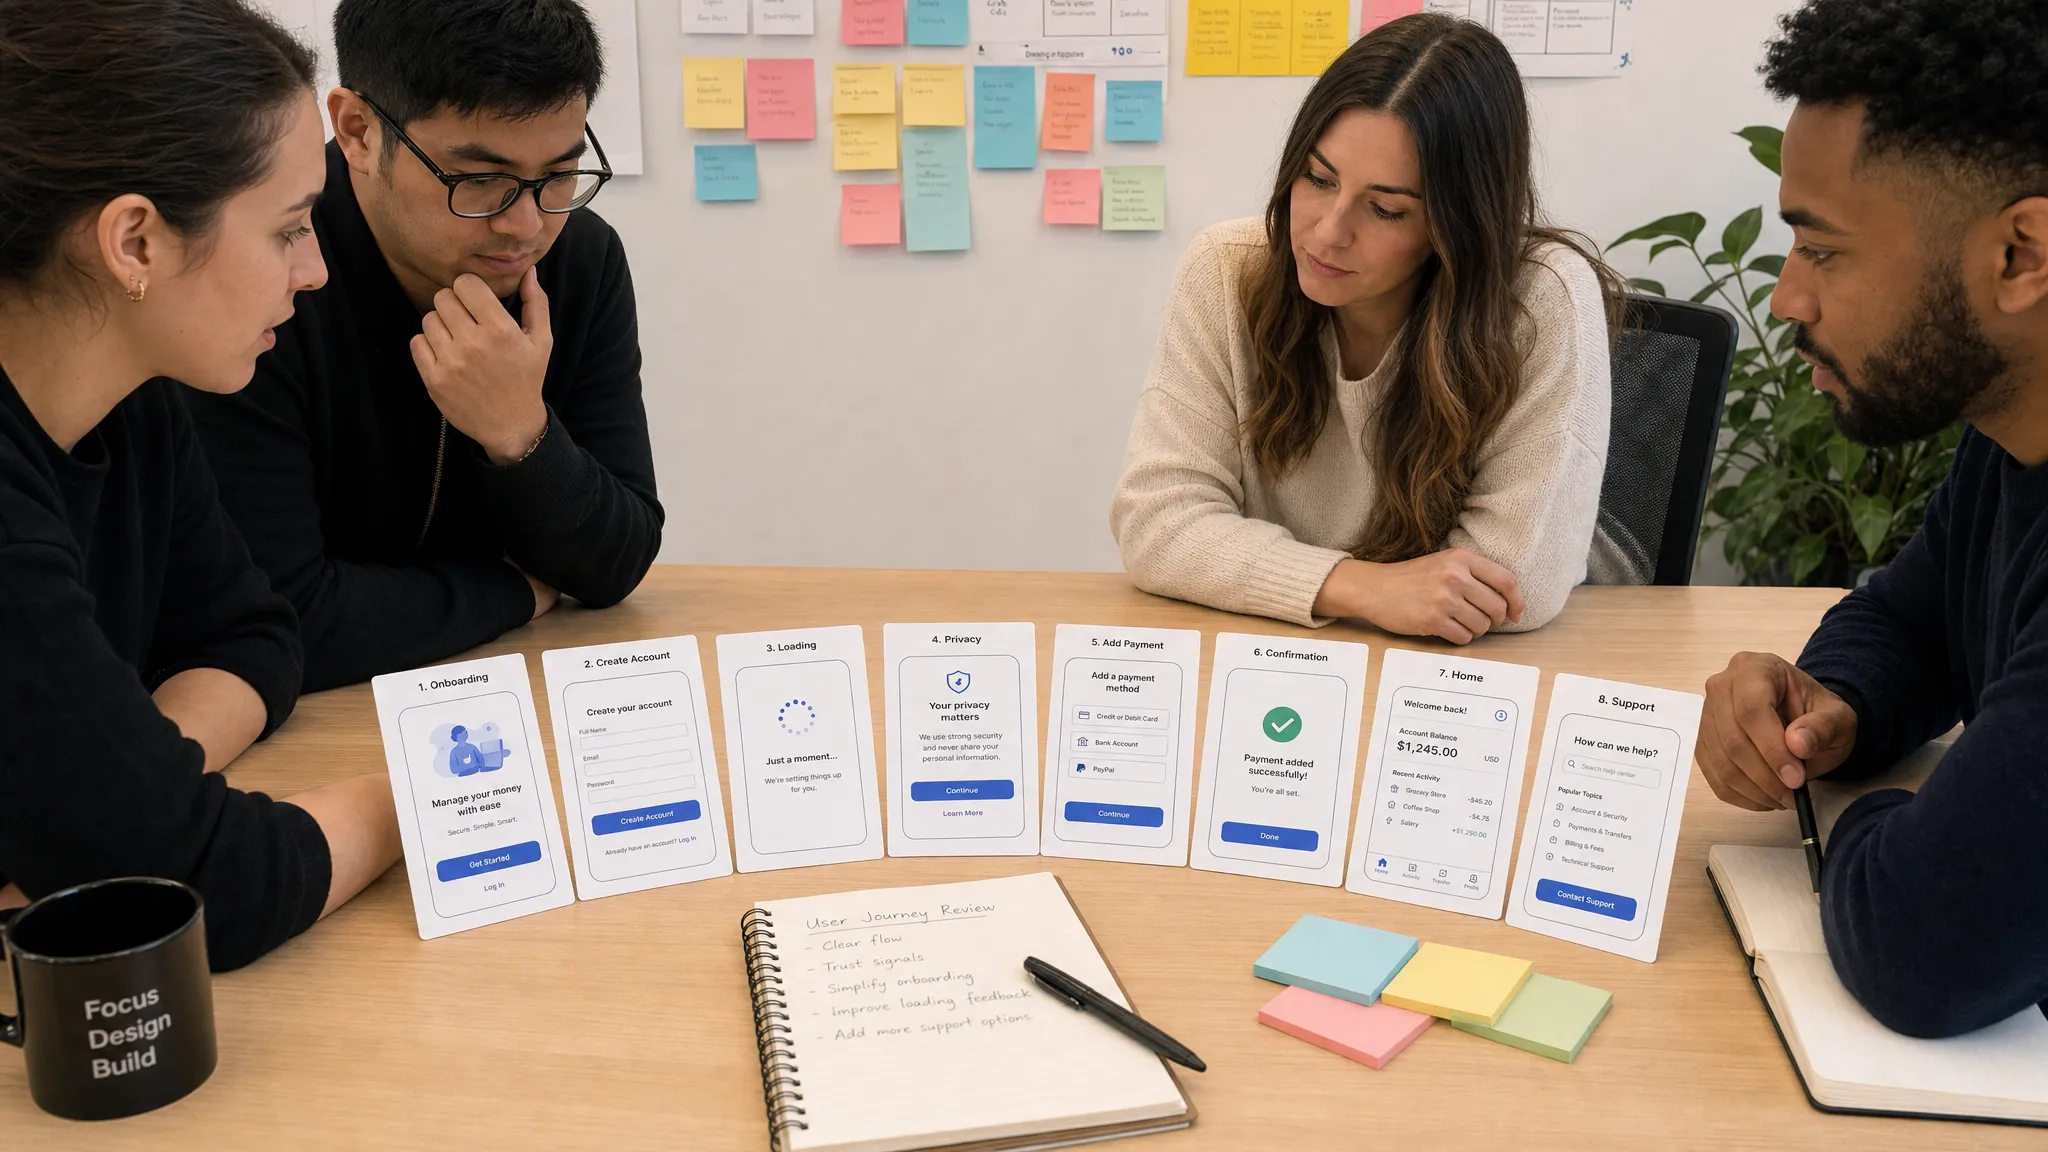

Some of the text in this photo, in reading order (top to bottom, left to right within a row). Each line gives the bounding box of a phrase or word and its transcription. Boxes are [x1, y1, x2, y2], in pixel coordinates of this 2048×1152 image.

[766, 642, 816, 652] 3. Loading
[932, 635, 981, 645] 4. Privacy
[1092, 638, 1164, 650] 5. Add Payment
[584, 652, 671, 668] 2. Create Account
[1254, 648, 1328, 662] 6. Confirmation
[418, 673, 488, 692] 1. Onboarding
[1091, 672, 1109, 680] Add
[1118, 674, 1155, 683] payment
[1440, 669, 1484, 682] 7. Home
[1106, 684, 1140, 693] method
[587, 700, 672, 716] Create your account
[929, 701, 990, 711] Your privacy
[1404, 700, 1467, 715] Welcome back!
[1598, 695, 1655, 713] 8. Support
[941, 713, 979, 721] matters
[948, 733, 971, 741] strong
[973, 732, 1003, 740] security
[1399, 728, 1458, 742] Account Balance
[1397, 741, 1458, 758] $1,245.00
[1574, 736, 1658, 759] How can we help?
[766, 757, 785, 765] Just
[794, 753, 838, 763] moment...
[922, 753, 1000, 763] personal information.
[1244, 754, 1314, 768] Payment added
[1484, 755, 1499, 763] USD
[1093, 766, 1114, 774] PayPal
[1249, 767, 1308, 780] successfully!
[1393, 770, 1440, 783] Recent Activity
[1581, 763, 1636, 779] Search help center
[587, 779, 614, 788] Password
[786, 775, 809, 783] setting
[810, 773, 832, 781] things
[432, 783, 522, 808] Manage your money
[1251, 786, 1274, 795] You're
[1406, 787, 1447, 799] Grocery Store
[1558, 786, 1602, 801] Popular Topics
[457, 802, 501, 817] with ease
[1098, 810, 1130, 818] Continue
[1403, 804, 1440, 815] Coffee Shop
[1571, 806, 1628, 822] Account & Security
[621, 811, 674, 825] Create Account
[448, 816, 517, 837] Secure. Simple. Smart.
[1568, 822, 1597, 834] Payments
[1604, 827, 1632, 840] Transfers
[605, 847, 627, 856] Already
[652, 839, 677, 848] account?
[678, 836, 688, 844] Log
[1565, 839, 1583, 850] Billing
[1590, 844, 1604, 853] Fees
[470, 854, 510, 869] Get Started
[1561, 856, 1614, 873] Technical Support
[484, 884, 496, 893] Log
[1557, 890, 1615, 909] Contact Support
[806, 904, 996, 929] User Journey Review
[822, 939, 861, 951] Clear
[870, 934, 902, 946] flow
[823, 959, 862, 973] Trust
[873, 953, 924, 969] signals
[827, 978, 887, 994] Simplify
[897, 971, 975, 986] onboarding
[85, 989, 159, 1020] Focus
[832, 1002, 891, 1018] Improve
[900, 996, 956, 1010] loading
[967, 989, 1033, 1005] feedback
[88, 1013, 172, 1049] Design
[835, 1027, 866, 1041] Add
[877, 1025, 911, 1036] more
[921, 1017, 973, 1034] support
[981, 1013, 1033, 1029] options
[92, 1046, 157, 1079] Build
